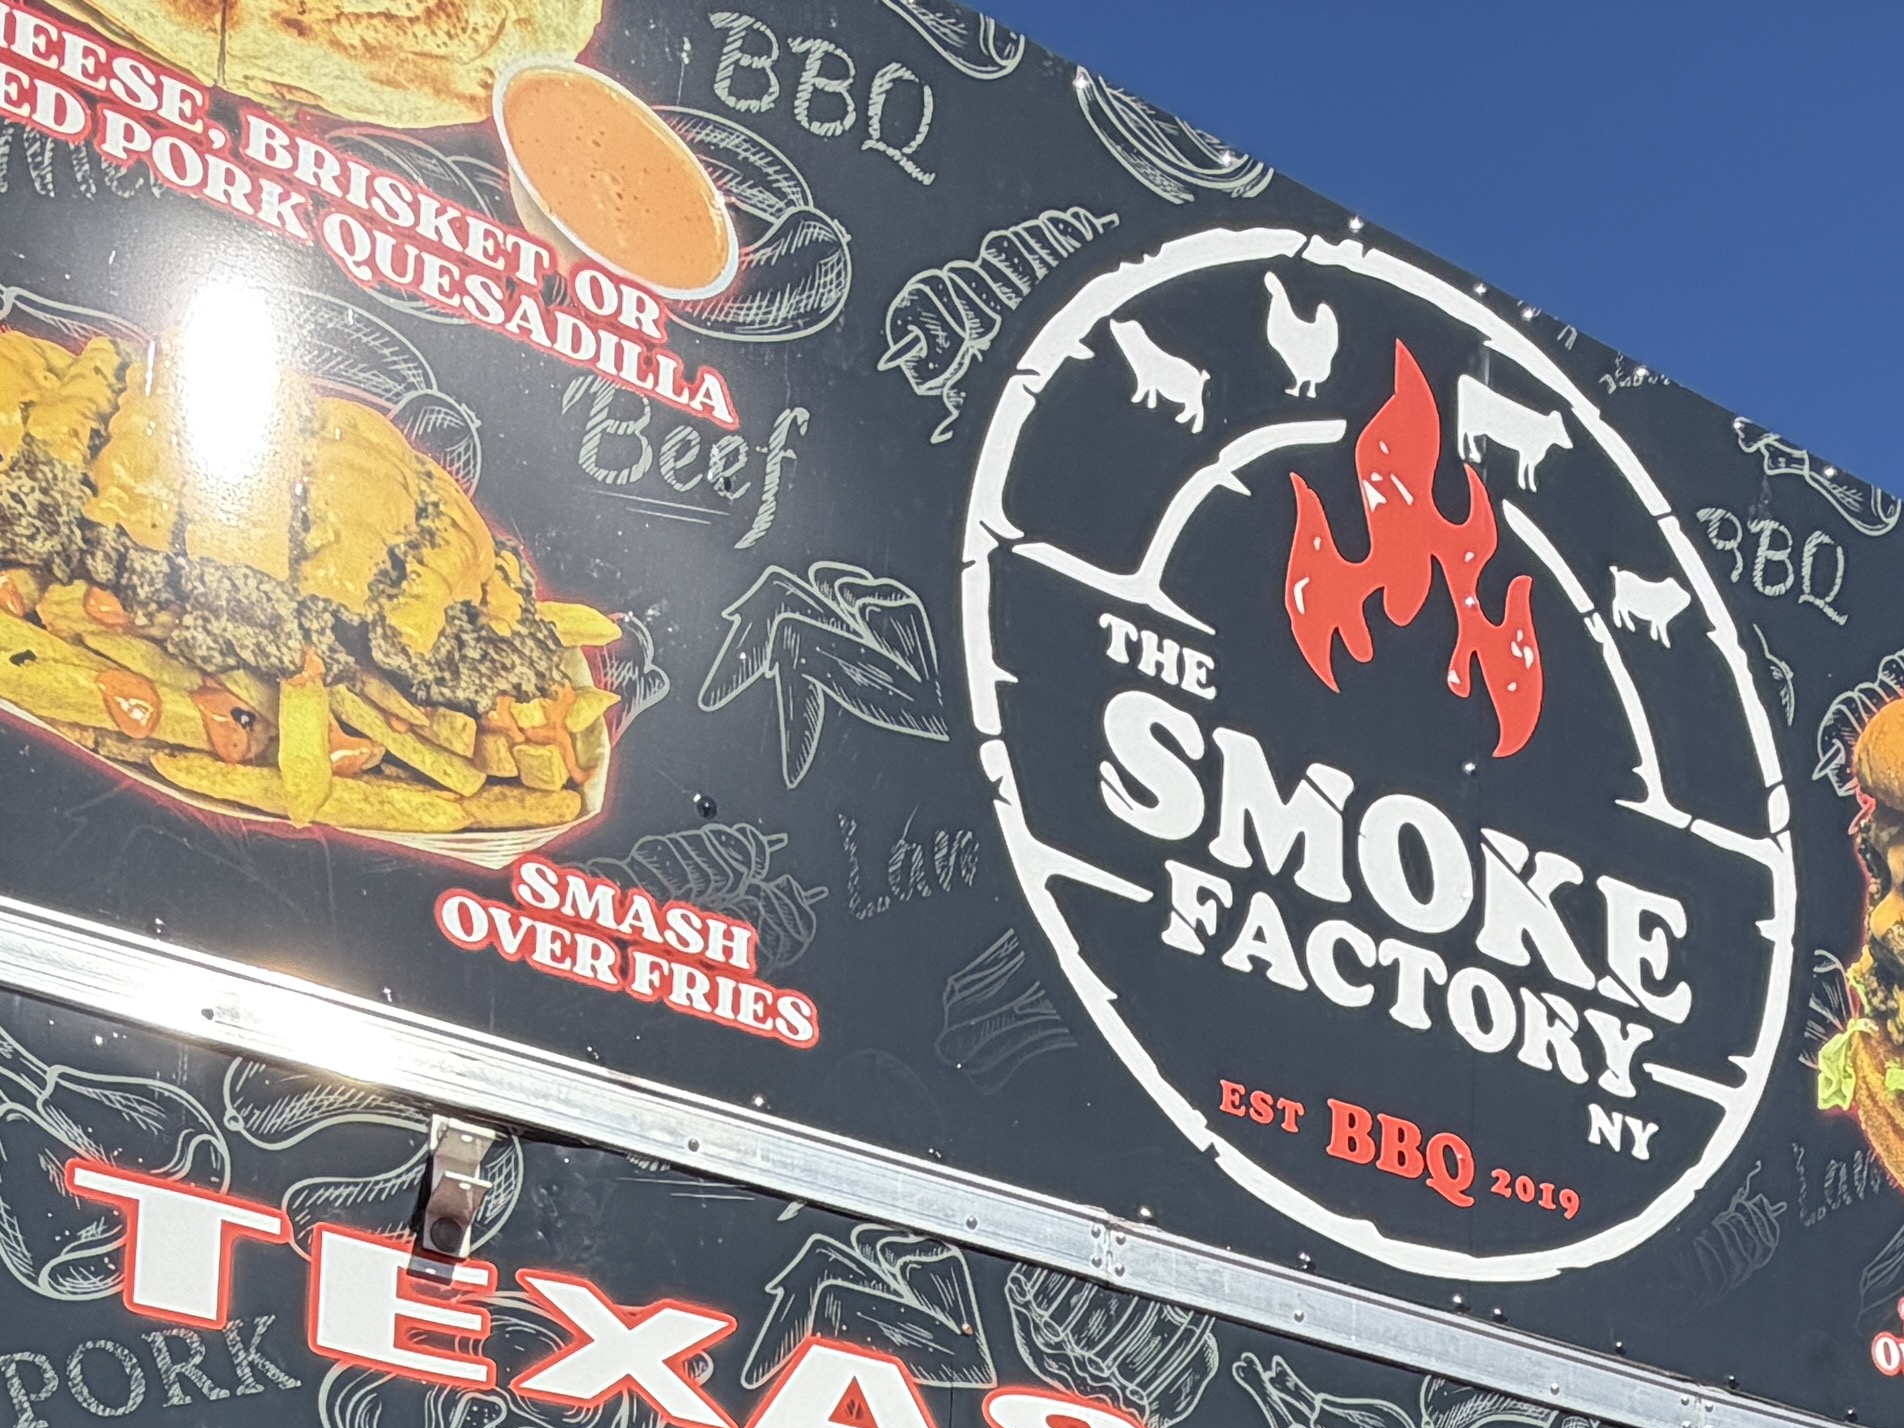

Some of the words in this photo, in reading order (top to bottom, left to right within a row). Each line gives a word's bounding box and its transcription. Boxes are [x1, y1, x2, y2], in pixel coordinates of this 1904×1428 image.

[709, 12, 936, 186] BBQ
[100, 108, 312, 241] PORK
[322, 212, 737, 426] QUESADILLA
[244, 113, 550, 285] BRISKET
[574, 268, 664, 339] OR
[562, 374, 810, 550] Beef
[1100, 614, 1216, 699] THE
[516, 861, 756, 971] SMASH
[1100, 690, 1692, 1023] SMOKE
[440, 896, 618, 984] OVER
[630, 952, 815, 1042] FRIES
[1161, 860, 1654, 1097] FACTORY
[1220, 1080, 1304, 1133] EST
[1326, 1099, 1475, 1208] BBQ
[1491, 1169, 1582, 1219] 2019
[1586, 1103, 1659, 1160] NY
